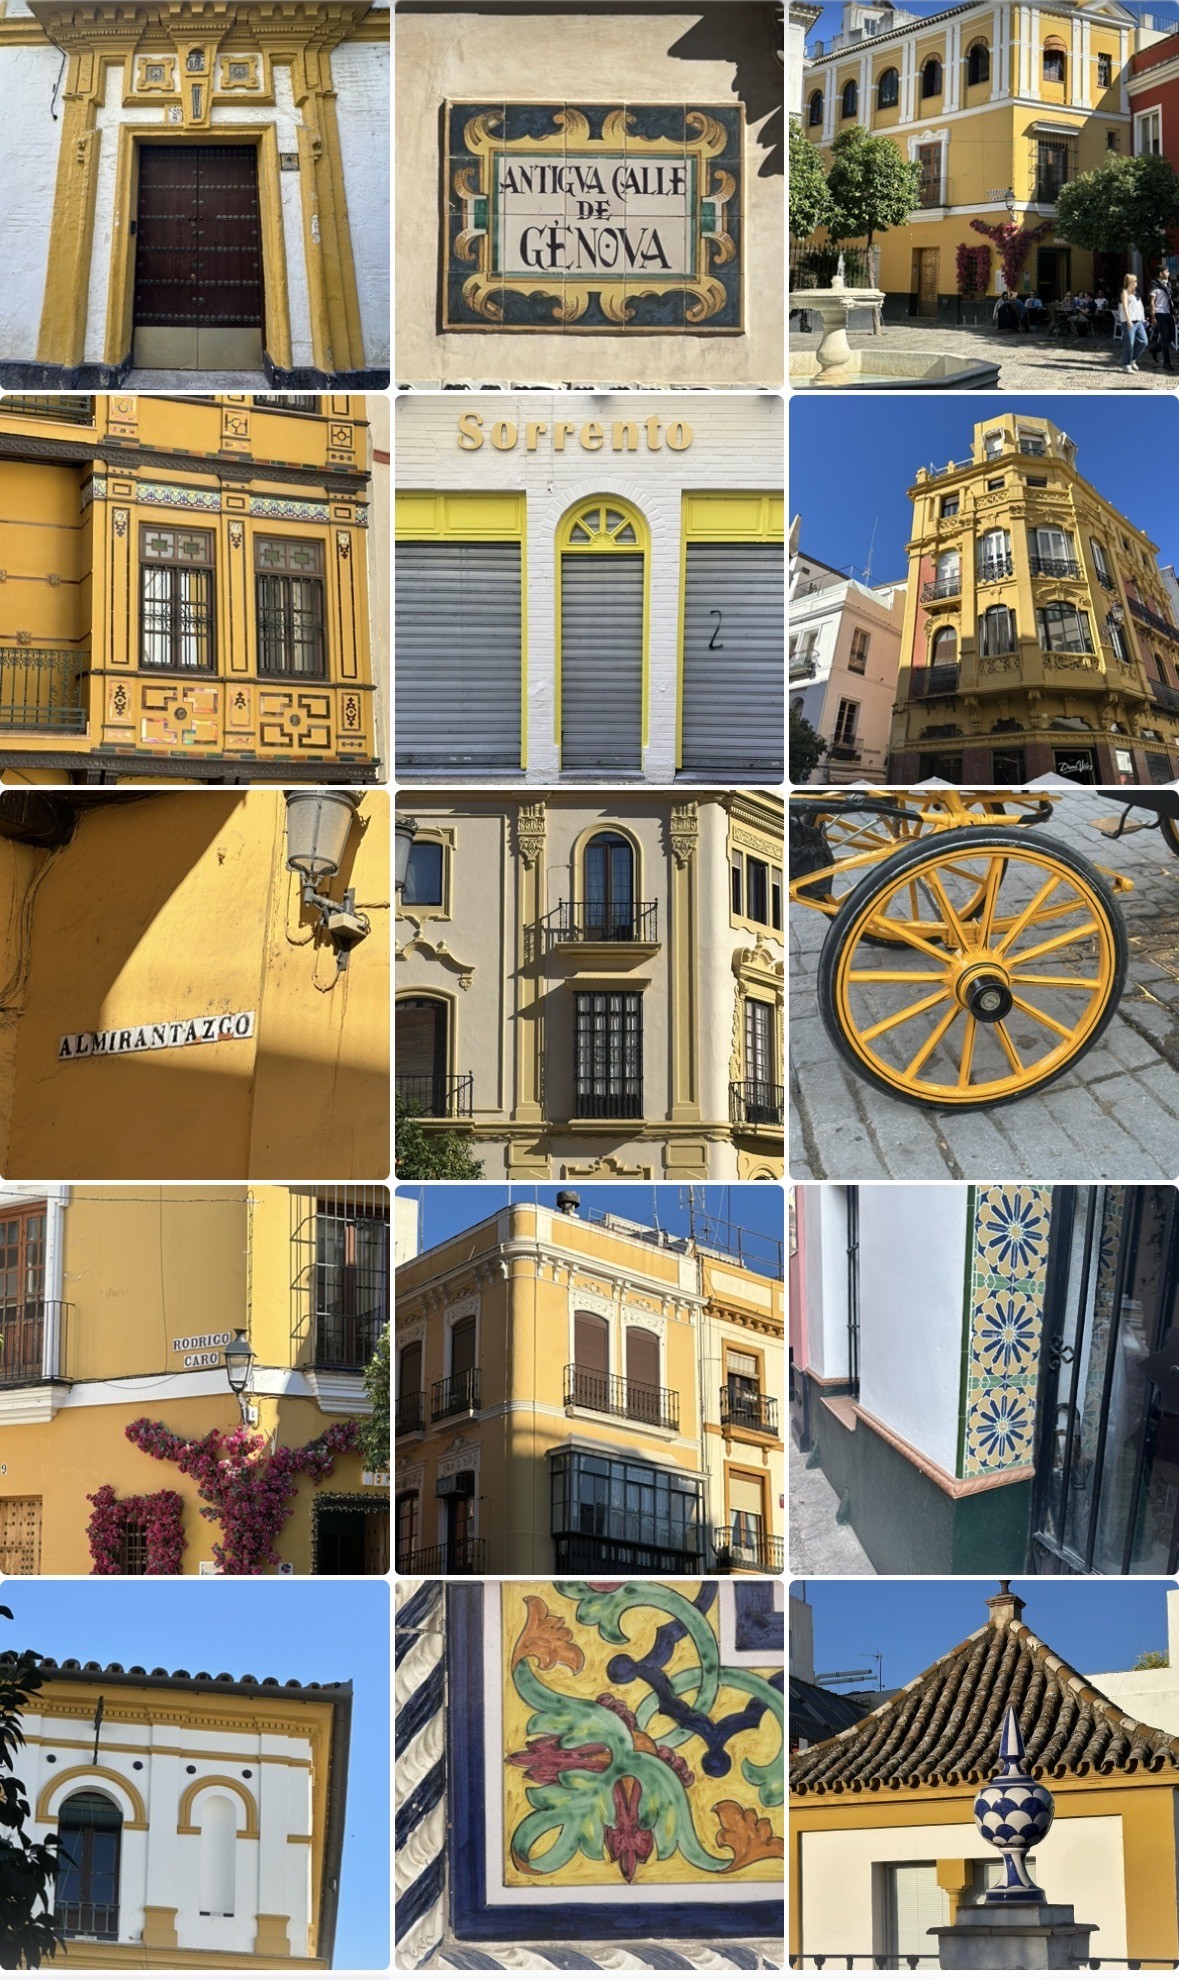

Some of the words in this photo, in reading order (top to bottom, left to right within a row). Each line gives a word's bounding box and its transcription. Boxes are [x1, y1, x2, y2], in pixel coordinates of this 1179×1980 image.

[499, 164, 607, 197] ANTIGVA
[611, 164, 688, 204] CALLE
[576, 199, 613, 222] DE
[456, 411, 694, 451] Sorrento
[59, 1013, 250, 1057] ALMIRANTAZGO
[173, 1333, 230, 1350] RODRIGO
[184, 1353, 218, 1367] CARO
